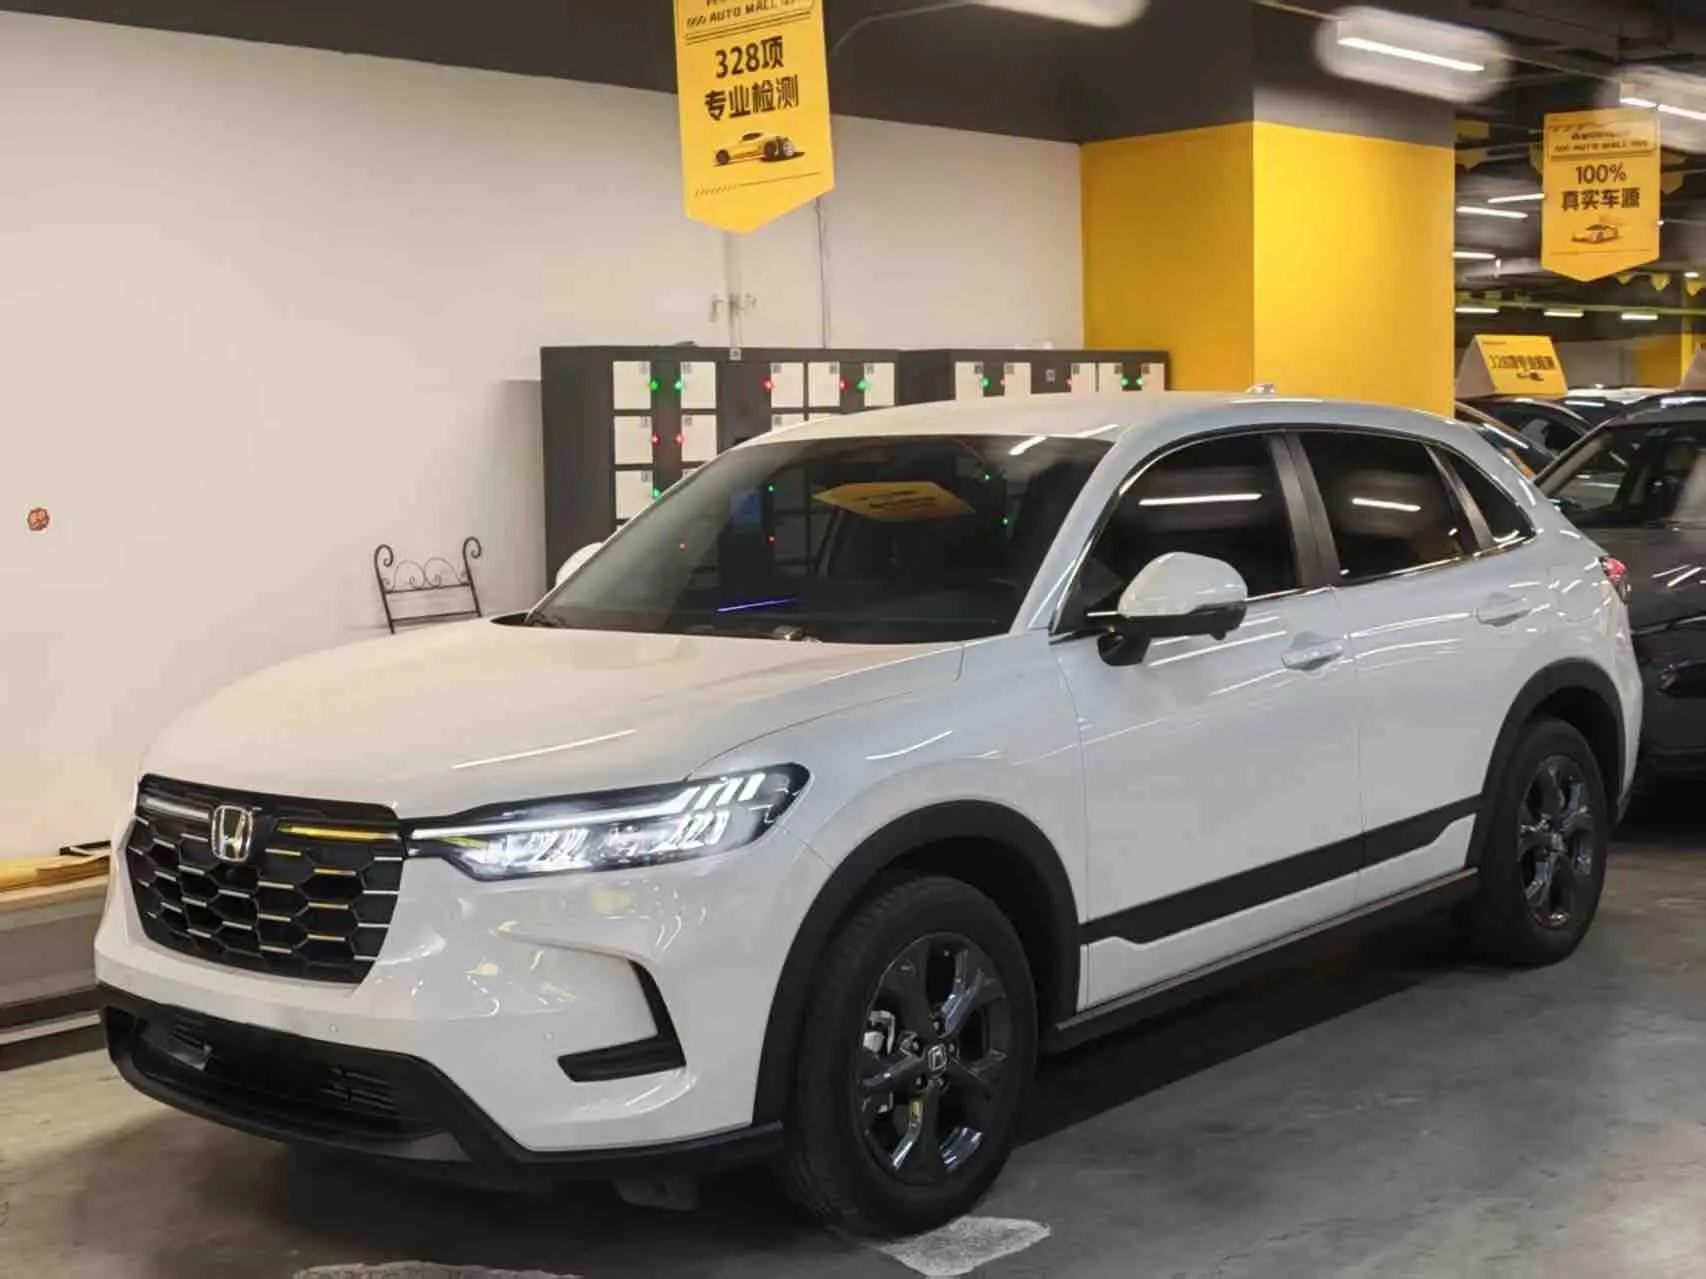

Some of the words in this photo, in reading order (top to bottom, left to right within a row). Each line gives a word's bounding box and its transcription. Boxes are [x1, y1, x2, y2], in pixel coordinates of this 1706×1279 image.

[715, 35, 784, 79] 328项
[704, 74, 800, 121] 专业检测
[1575, 161, 1627, 184] 100%
